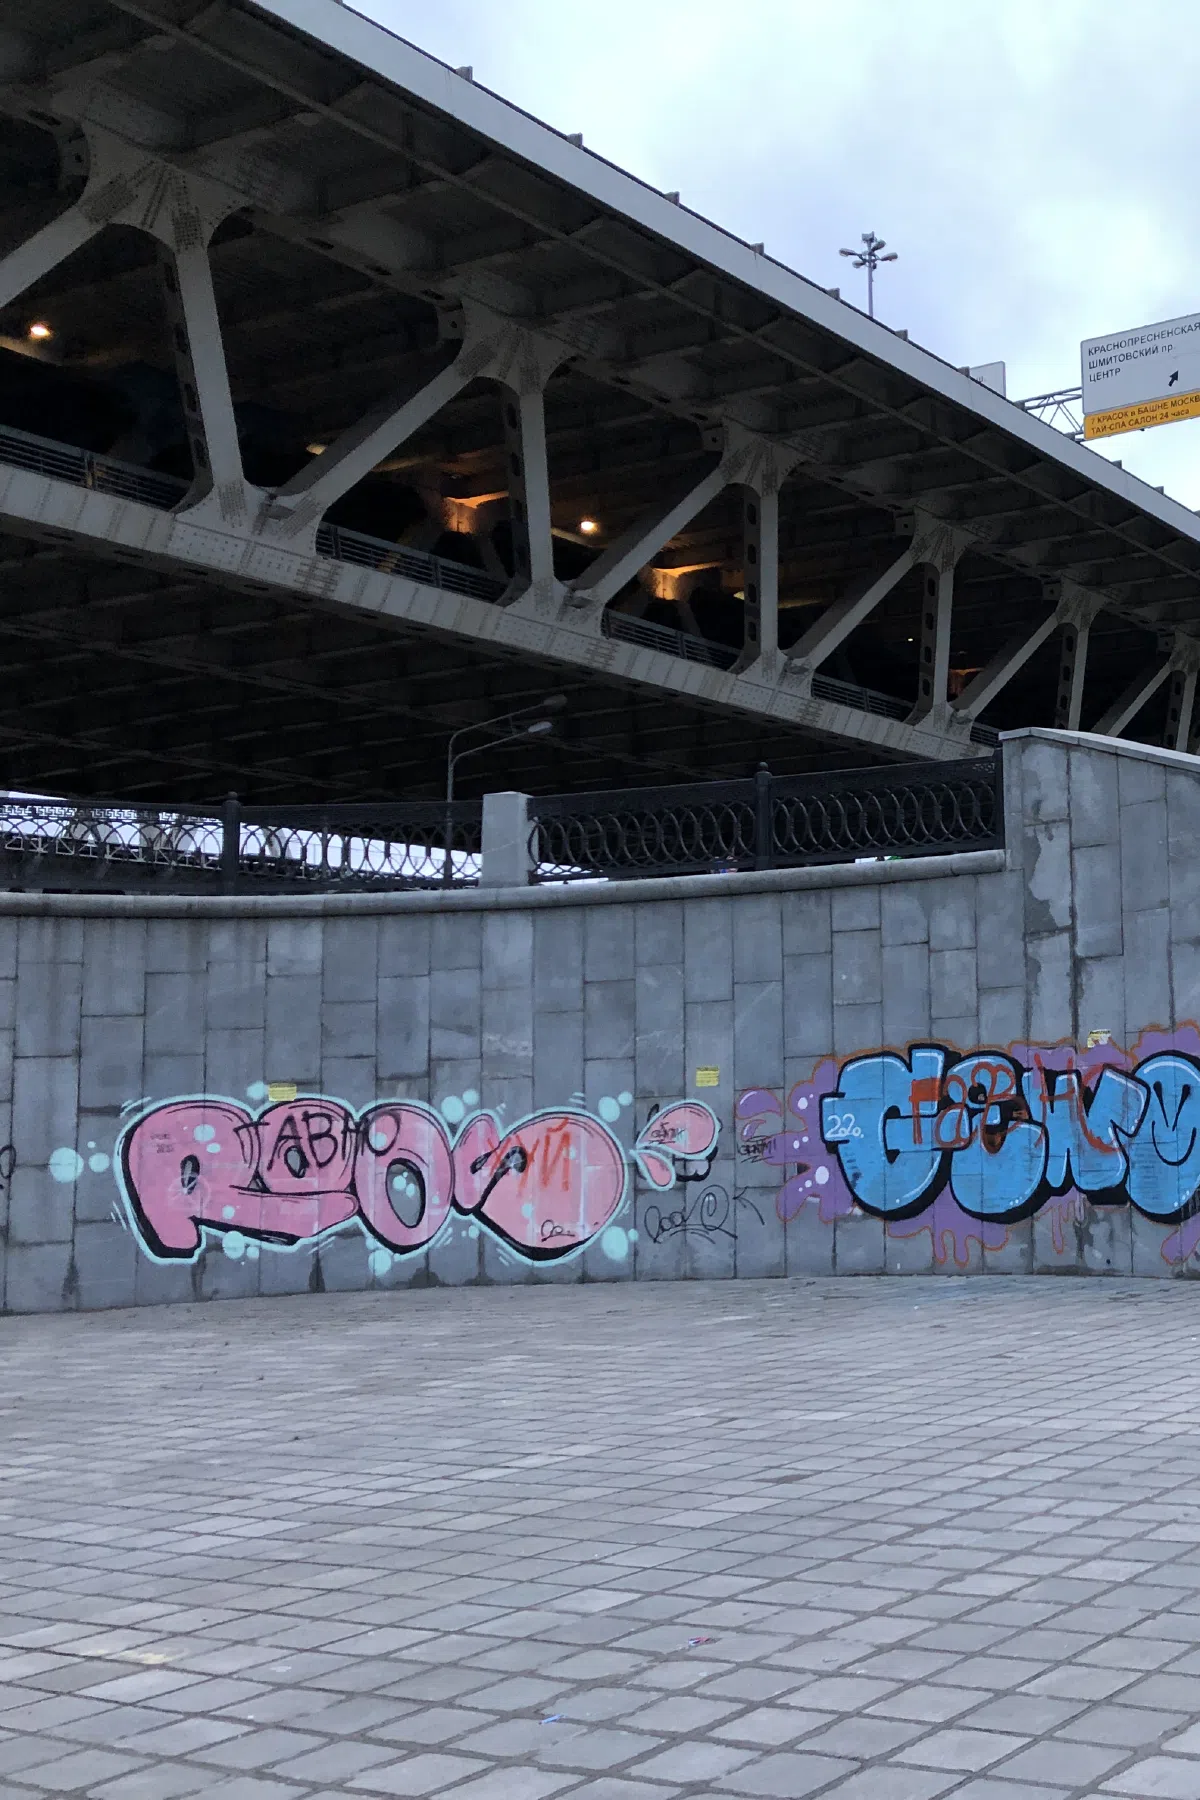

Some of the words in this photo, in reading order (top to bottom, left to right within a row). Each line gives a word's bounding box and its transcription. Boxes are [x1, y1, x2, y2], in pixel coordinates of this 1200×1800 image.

[1088, 322, 1200, 356] КРАСНОПРЕСНЕНСКАЯ
[1088, 345, 1159, 370] ШМИТОВСКИЙ
[1089, 367, 1121, 383] ЦЕНТР
[1128, 414, 1158, 428] САЛОН
[1159, 411, 1169, 420] 24
[1170, 408, 1190, 417] часа
[1137, 401, 1169, 415] БАШНЕ
